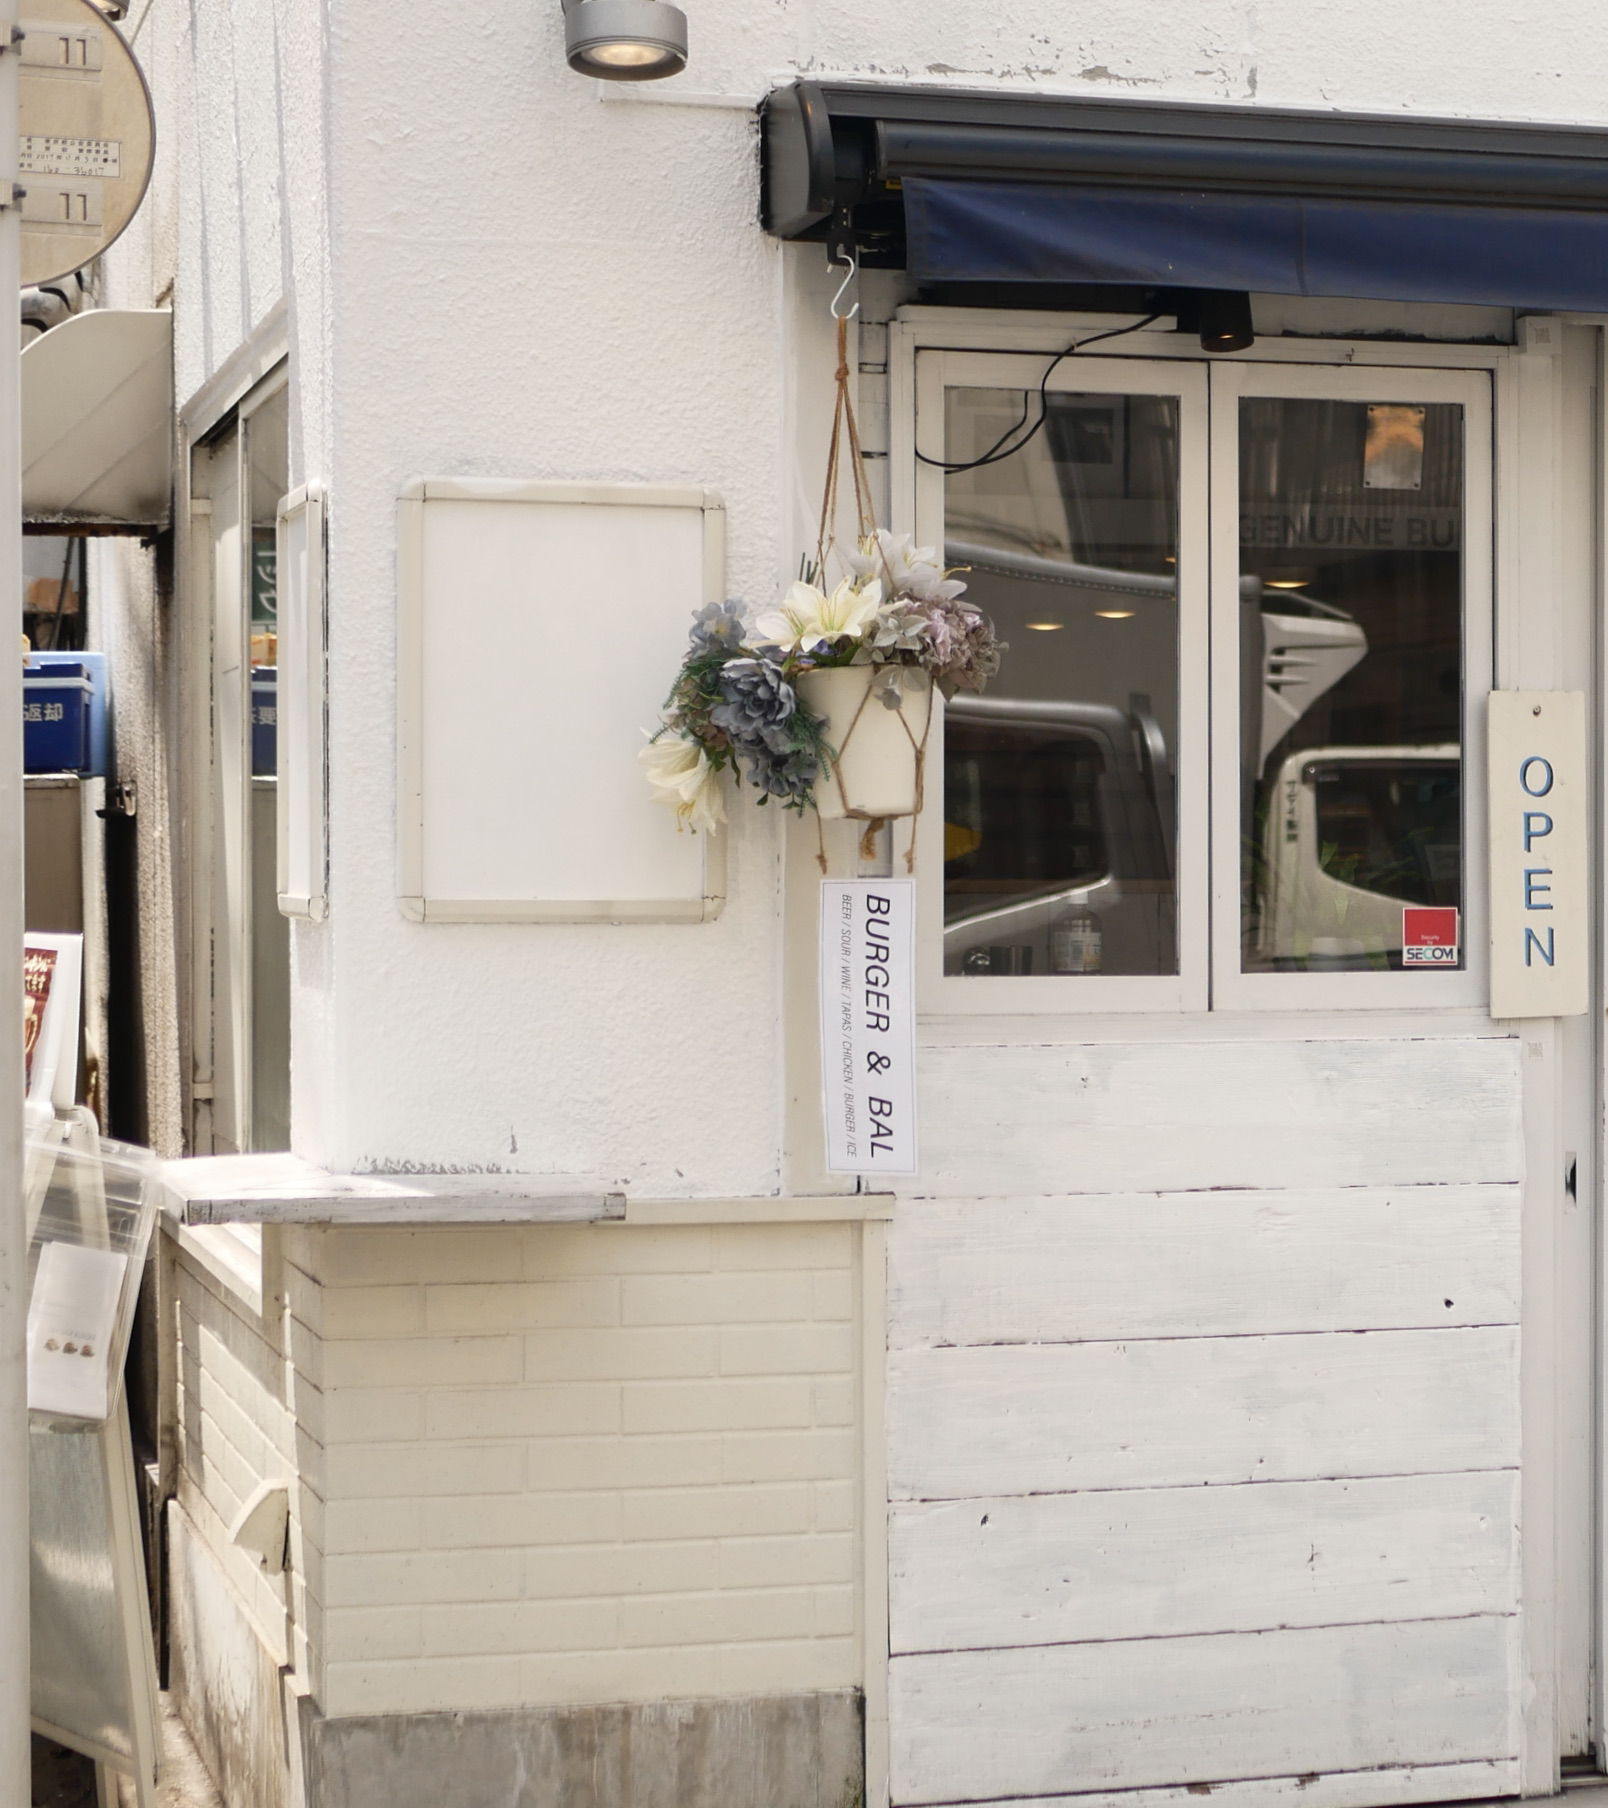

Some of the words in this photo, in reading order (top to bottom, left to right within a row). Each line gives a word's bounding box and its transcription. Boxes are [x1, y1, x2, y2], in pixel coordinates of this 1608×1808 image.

[1406, 517, 1462, 548] BU
[1519, 756, 1555, 967] OPEN
[841, 894, 852, 919] BEER
[841, 928, 852, 956] SOUR
[1407, 947, 1454, 960] SECOM
[841, 966, 852, 992] WINE
[864, 894, 891, 1033] BURGER
[841, 1001, 852, 1032] TAPAS
[842, 1041, 854, 1083] CHICKEN
[866, 1051, 892, 1076] &
[844, 1092, 856, 1133] BURGER
[868, 1096, 894, 1158] BAL
[846, 1140, 857, 1159] ICE
